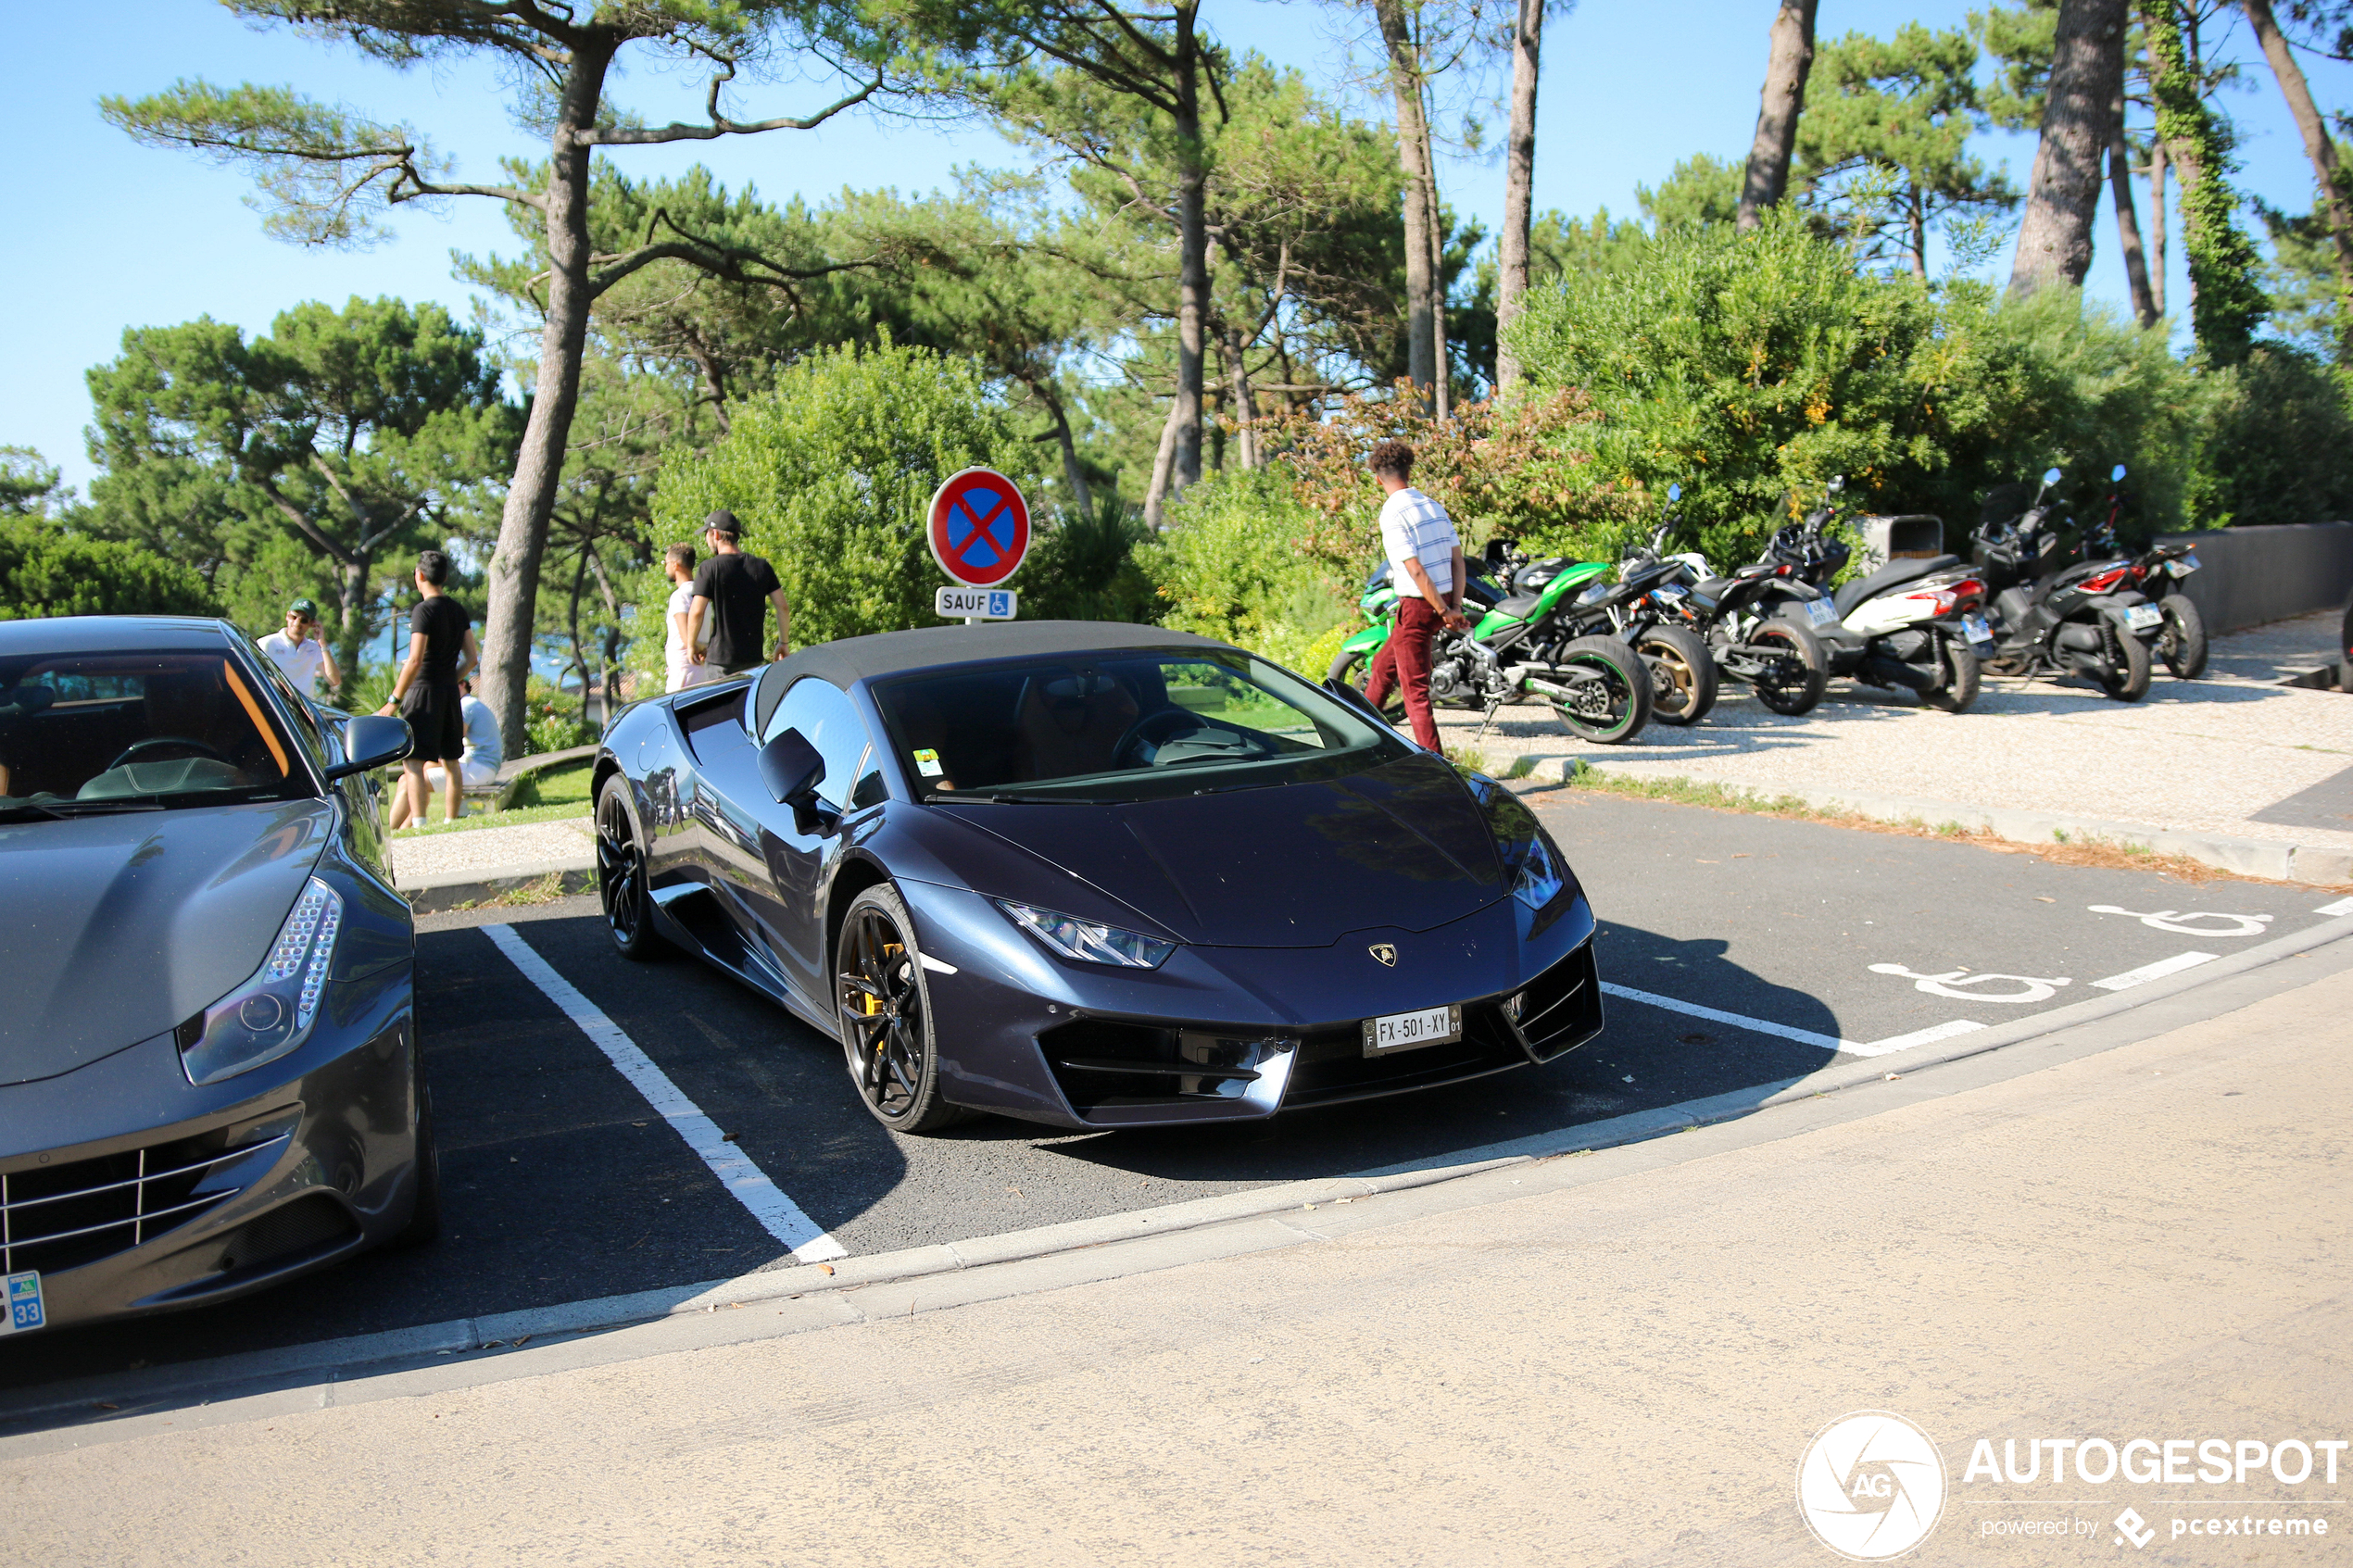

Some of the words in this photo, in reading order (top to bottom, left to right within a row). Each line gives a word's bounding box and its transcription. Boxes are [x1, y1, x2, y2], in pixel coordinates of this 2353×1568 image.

[943, 594, 986, 610] SAUF
[1379, 1012, 1445, 1042] FX-501-XY
[1451, 1021, 1461, 1032] 01
[1366, 1035, 1374, 1047] F
[15, 1302, 40, 1323] 33
